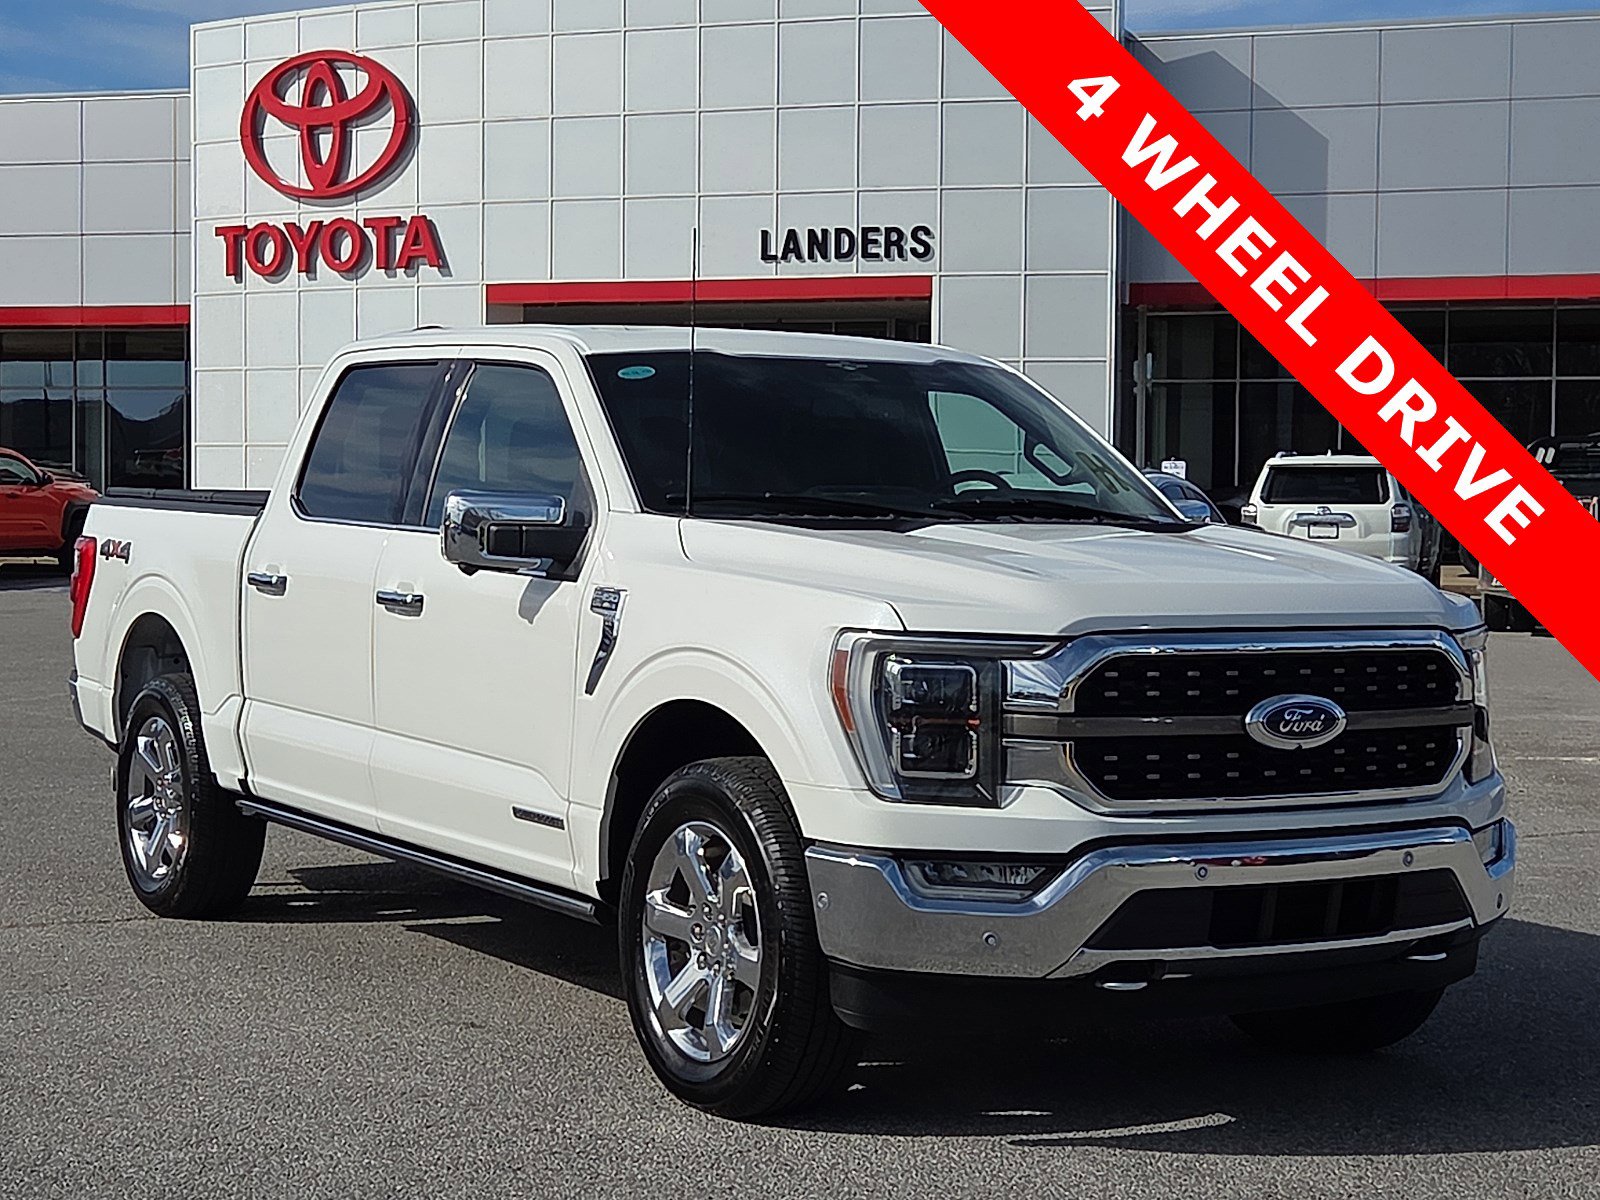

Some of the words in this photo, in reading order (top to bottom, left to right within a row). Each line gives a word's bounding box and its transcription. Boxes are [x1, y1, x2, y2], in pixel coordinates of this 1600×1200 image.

[215, 215, 442, 276] TOYOTA
[760, 225, 935, 261] LANDERS
[1279, 708, 1326, 733] Ford
